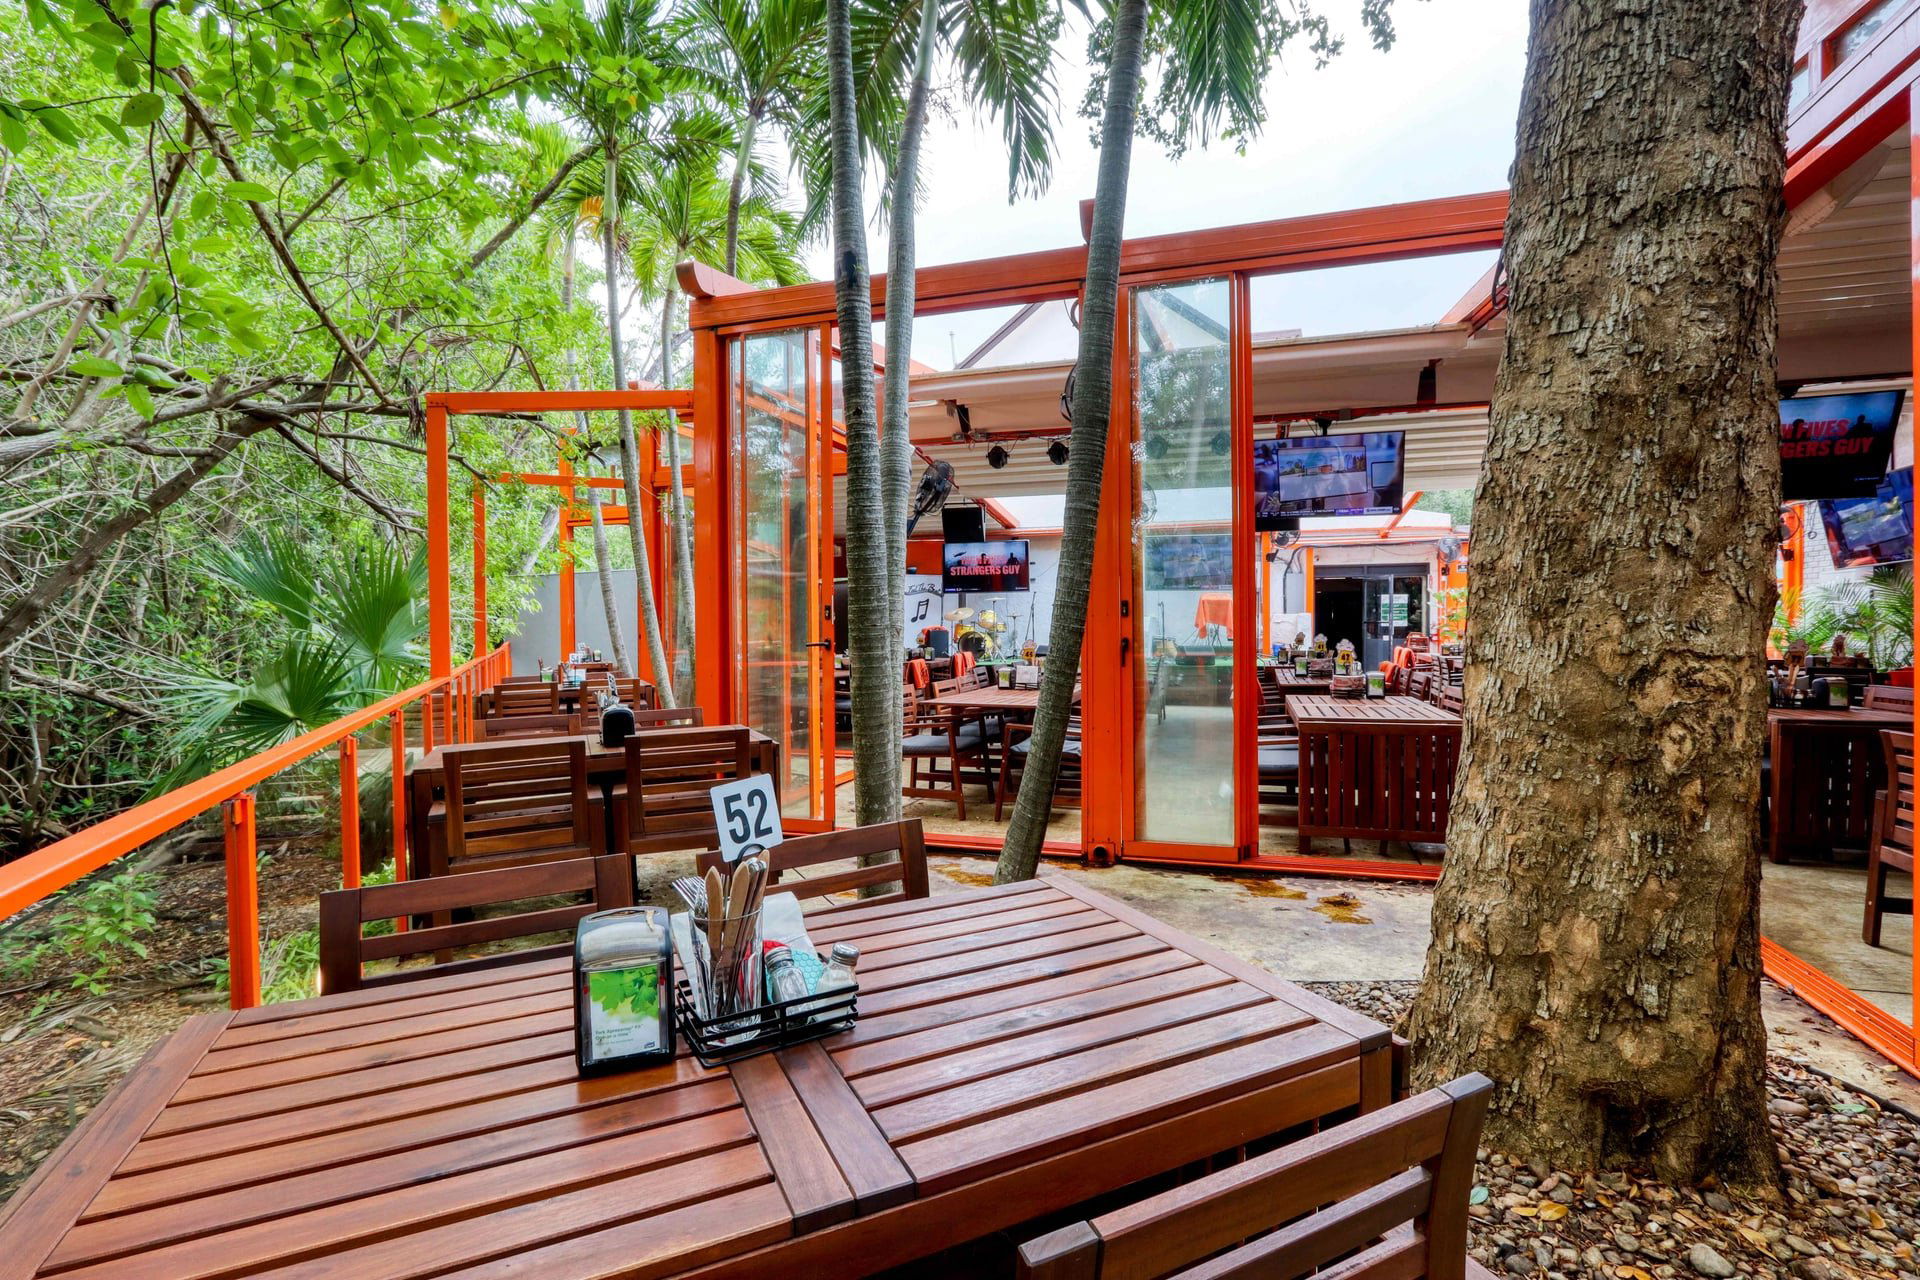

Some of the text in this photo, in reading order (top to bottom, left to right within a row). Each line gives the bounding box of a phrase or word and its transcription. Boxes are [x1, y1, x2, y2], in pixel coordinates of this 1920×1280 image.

[1833, 437, 1874, 456] GUY
[950, 564, 1020, 576] STRANGERS GUY
[723, 788, 773, 844] 52
